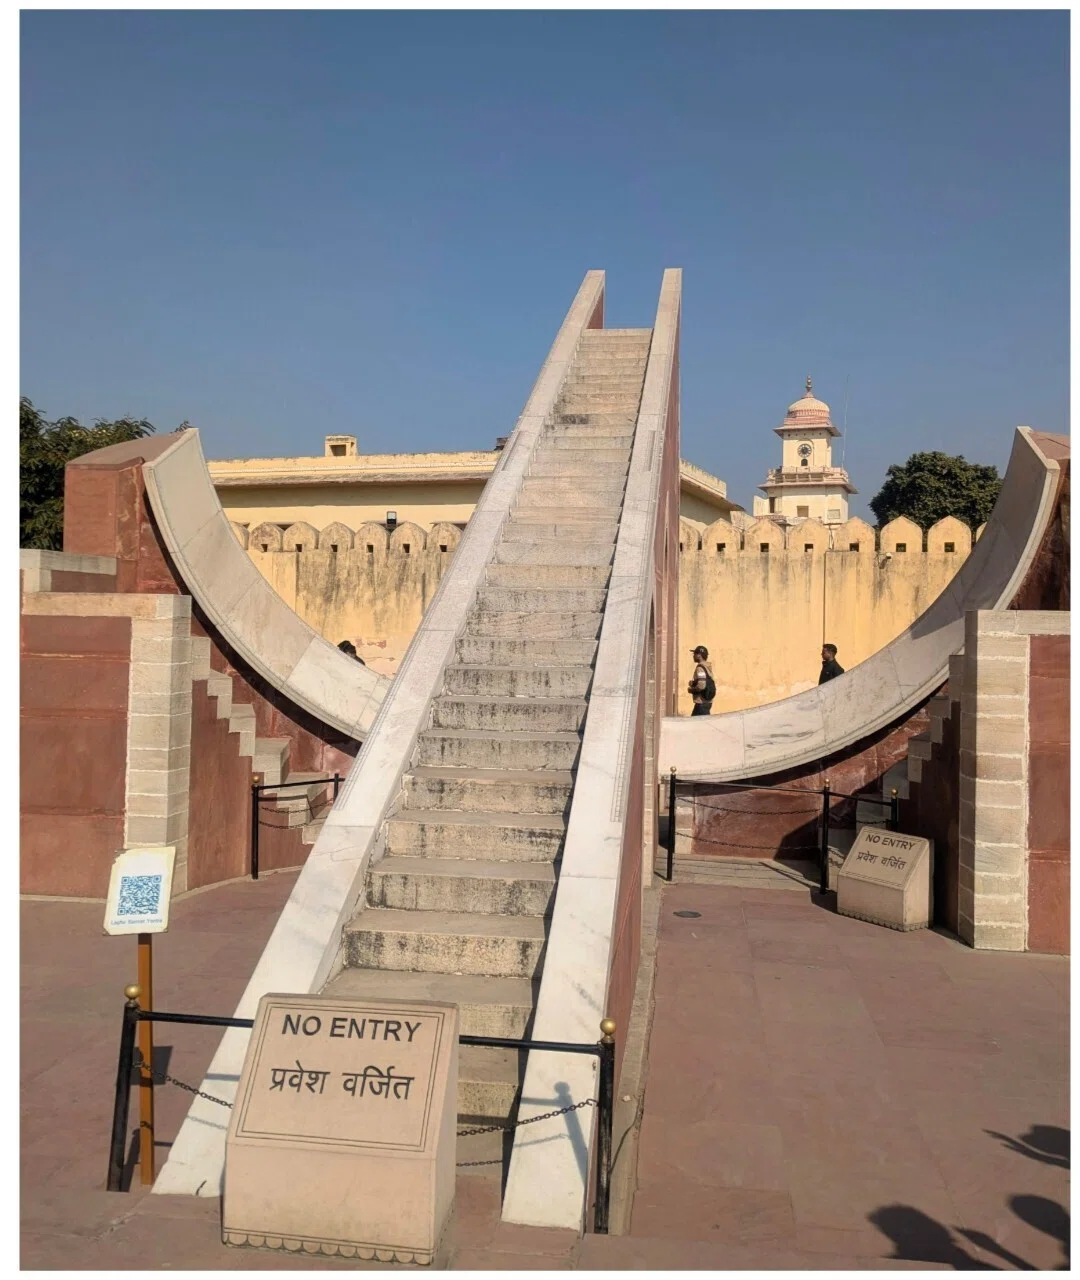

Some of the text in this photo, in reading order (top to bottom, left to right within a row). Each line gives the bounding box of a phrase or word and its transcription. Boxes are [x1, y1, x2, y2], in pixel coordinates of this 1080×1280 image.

[865, 834, 916, 851] NO ENTRY
[856, 850, 907, 870] प्रवेश वर्जित
[281, 1014, 422, 1043] NO ENTRY
[269, 1059, 415, 1100] प्रवेश वर्जित
